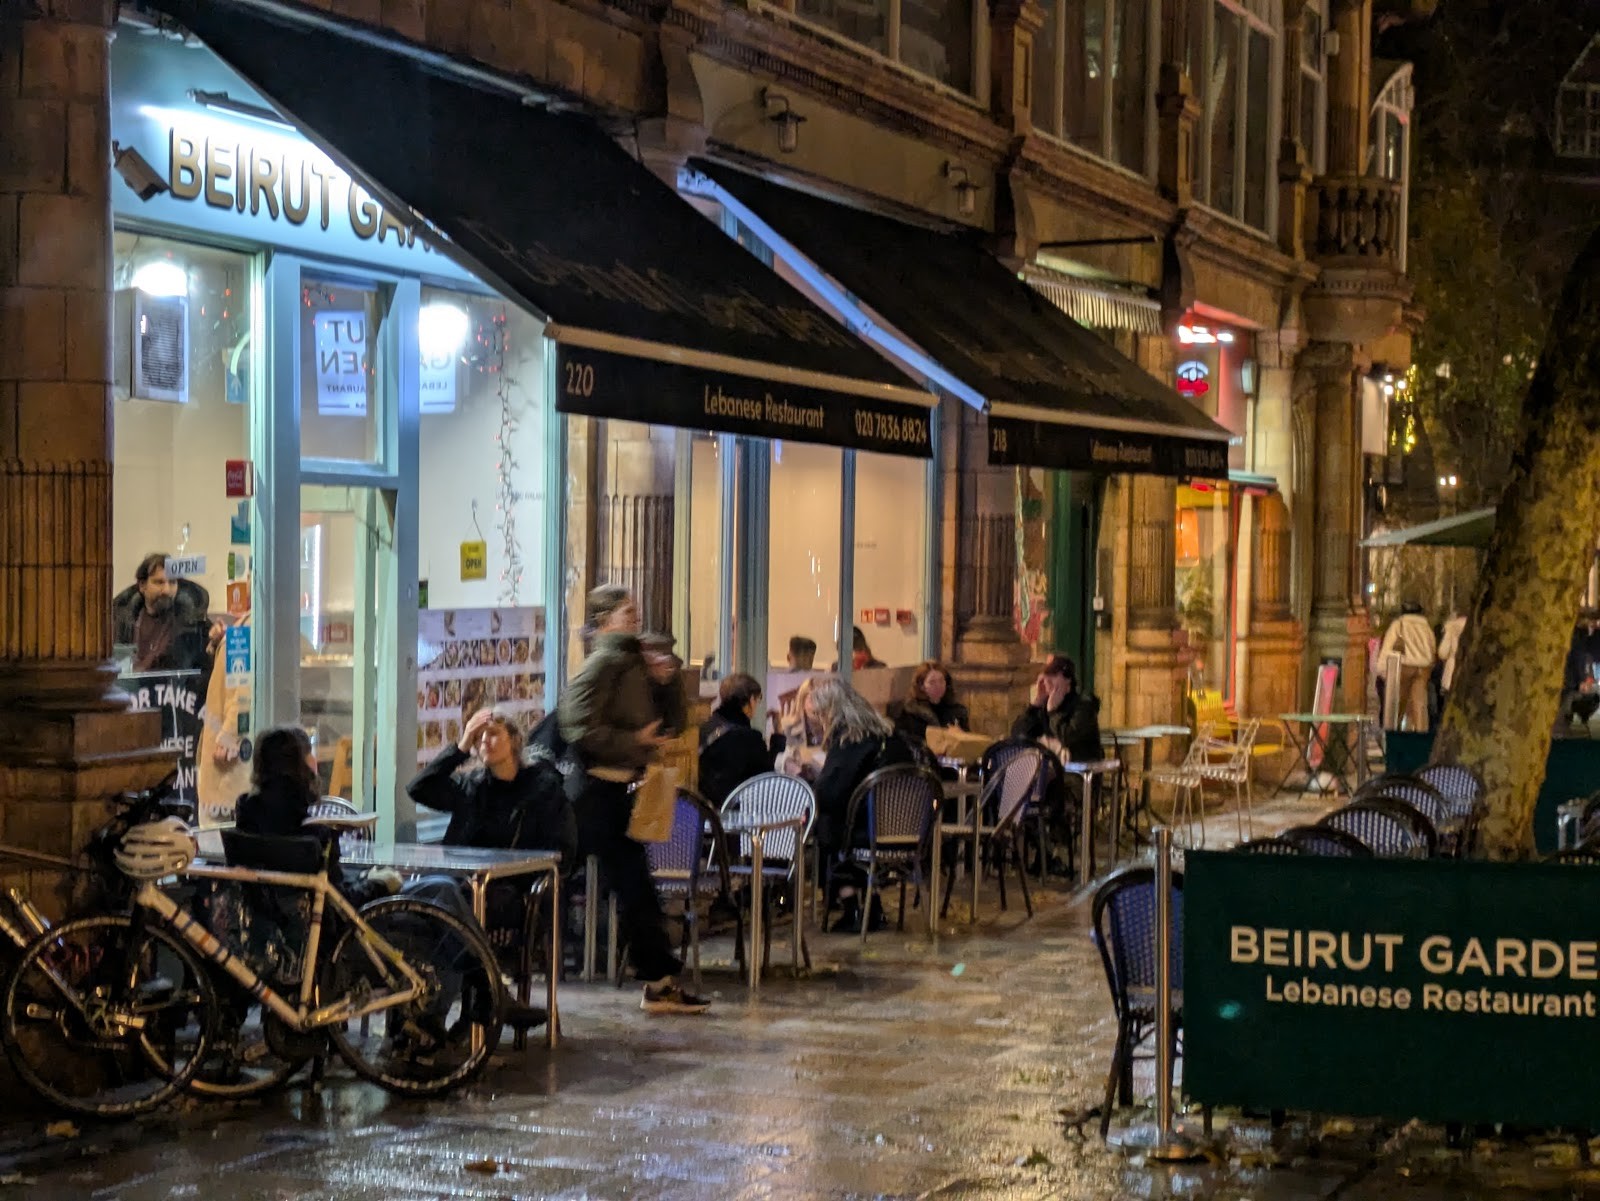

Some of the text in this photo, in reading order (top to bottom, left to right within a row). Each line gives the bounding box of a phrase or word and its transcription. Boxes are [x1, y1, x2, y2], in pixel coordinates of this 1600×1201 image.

[169, 127, 431, 252] BEIRUT GA
[566, 362, 594, 397] 220
[704, 385, 824, 429] Lebanese Restaurant
[855, 409, 927, 444] 020 7836 8824
[171, 560, 198, 575] OPEN
[154, 683, 197, 716] TAKE
[1230, 925, 1598, 980] BEIRUT GARDE
[1266, 975, 1596, 1018] Lebanese Restaurant
